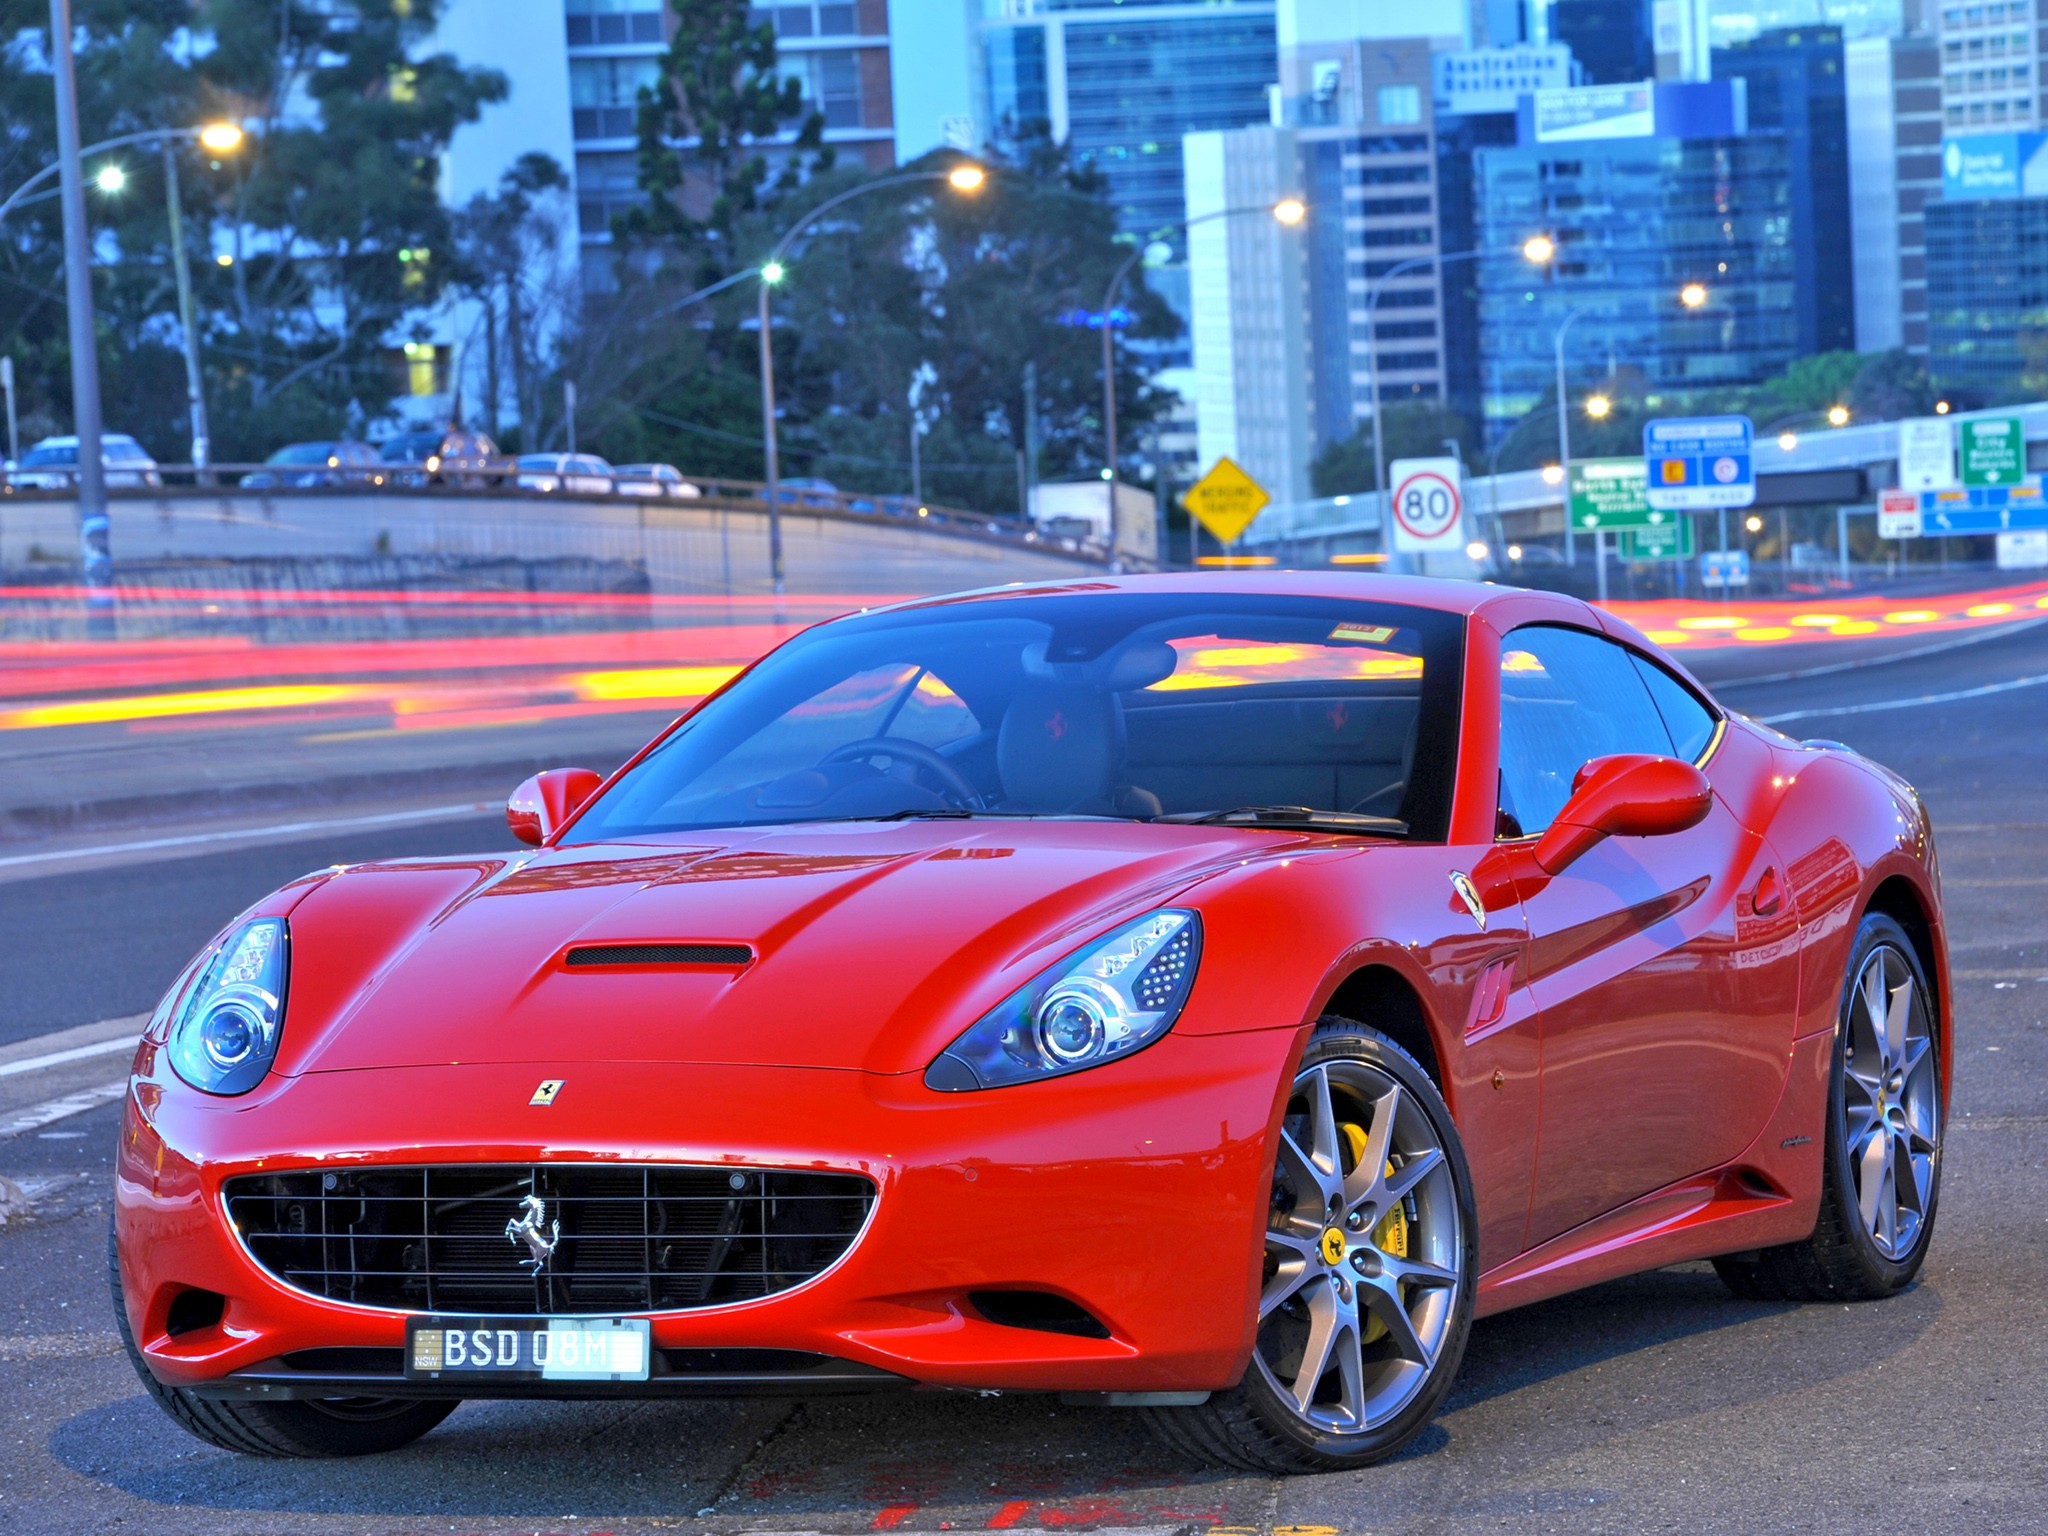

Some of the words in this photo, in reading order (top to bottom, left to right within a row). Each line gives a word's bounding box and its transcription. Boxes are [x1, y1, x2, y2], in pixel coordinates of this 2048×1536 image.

[1405, 488, 1449, 521] 80
[414, 1356, 438, 1367] NSW
[444, 1329, 519, 1367] BSD
